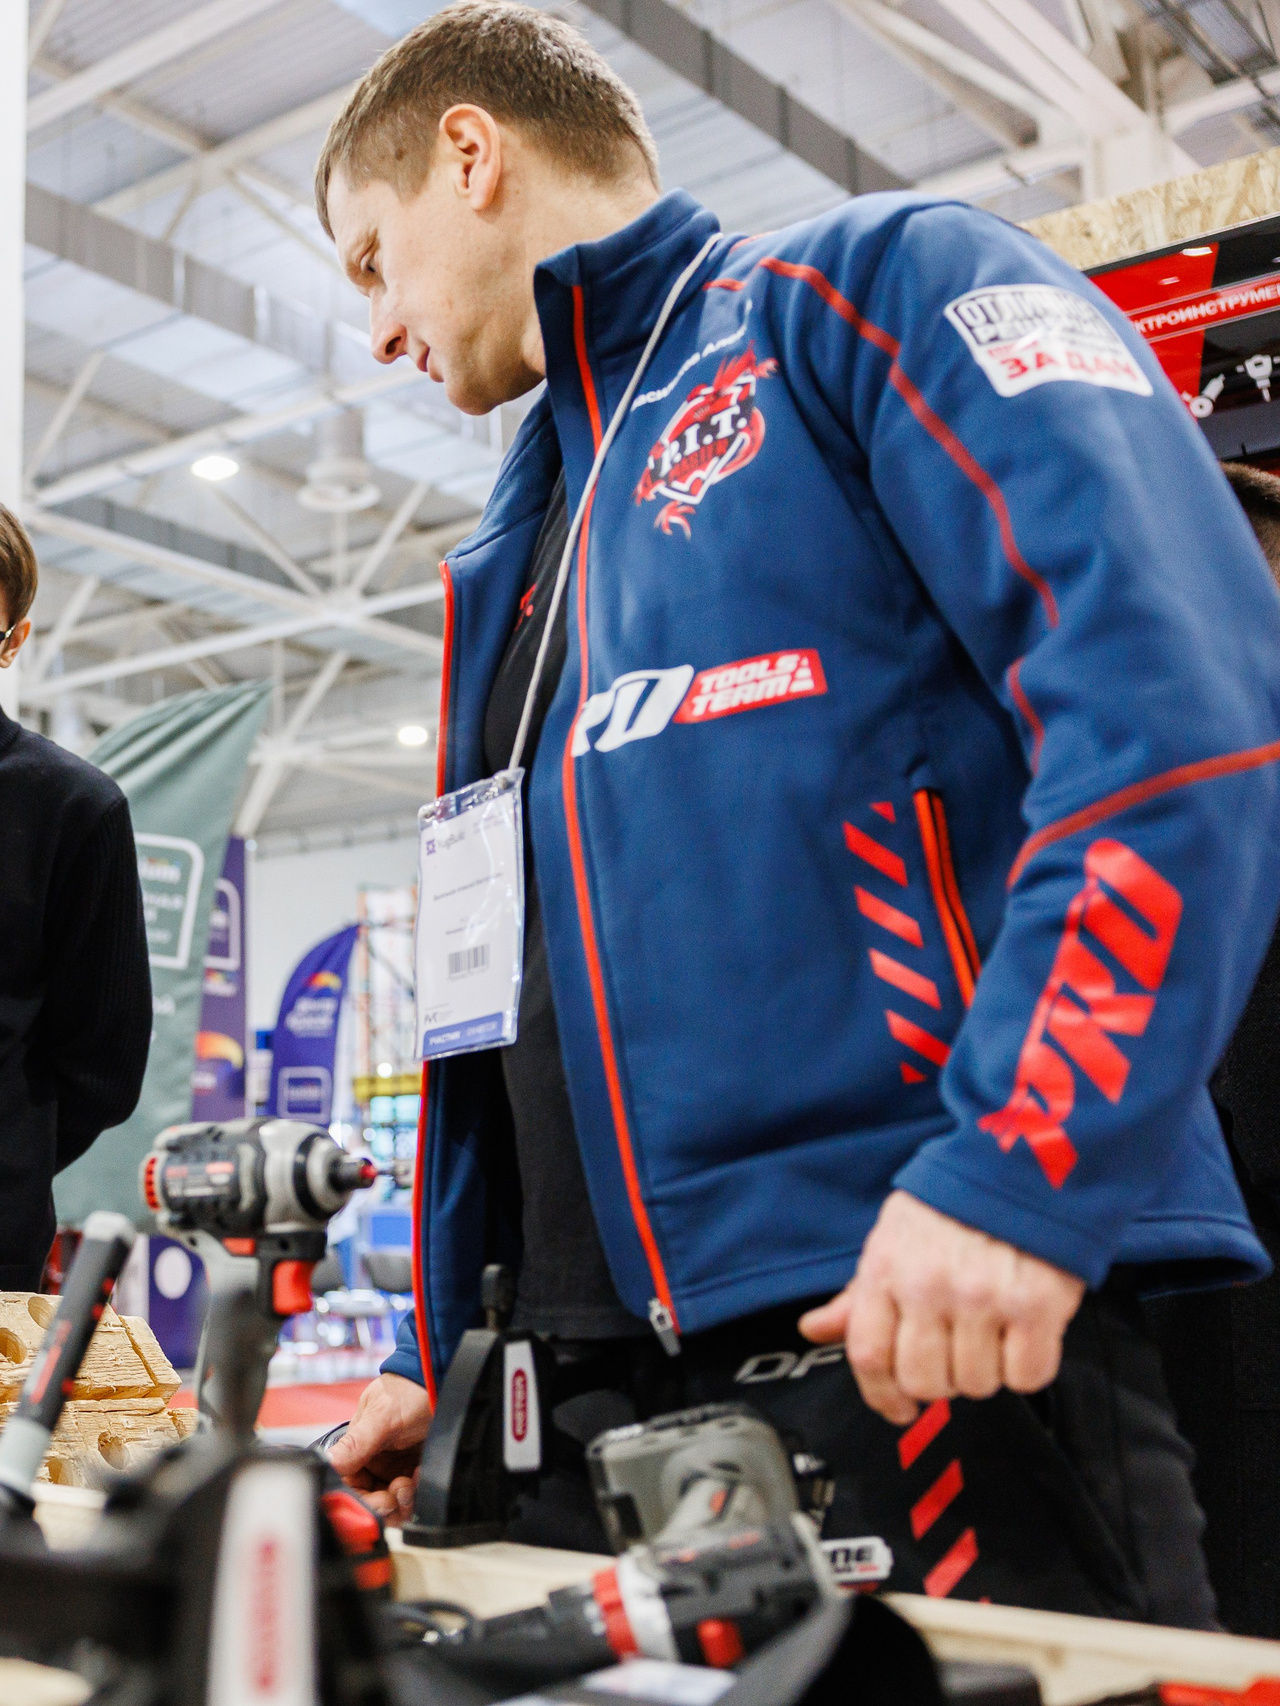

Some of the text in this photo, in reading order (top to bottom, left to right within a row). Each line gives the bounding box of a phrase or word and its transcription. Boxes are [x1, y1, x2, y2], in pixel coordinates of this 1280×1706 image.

[1133, 284, 1280, 333] КТРОИНСТРУМЕ
[699, 654, 800, 693] TOOLS
[692, 674, 792, 716] TEAM
